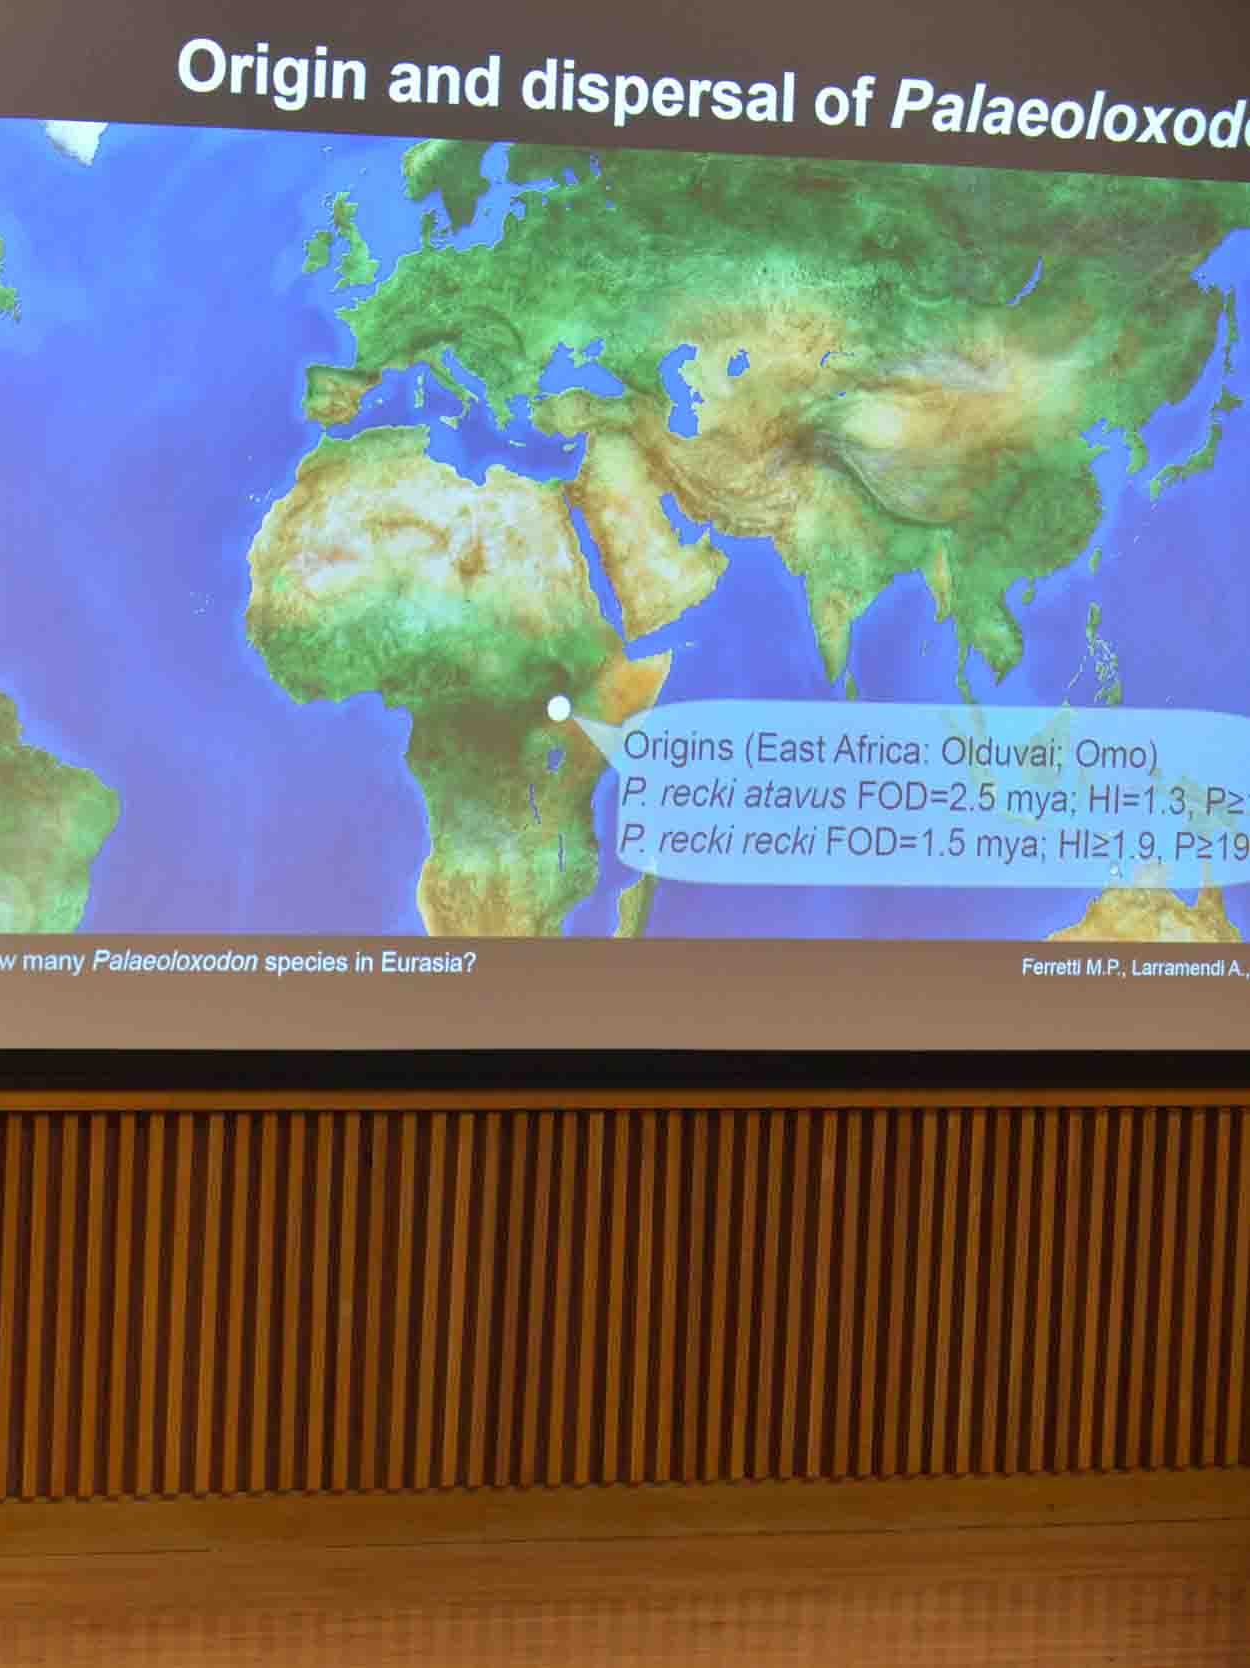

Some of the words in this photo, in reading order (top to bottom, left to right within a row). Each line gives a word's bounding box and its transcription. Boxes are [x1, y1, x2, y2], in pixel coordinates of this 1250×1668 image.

[177, 37, 367, 112] Origin
[387, 54, 502, 107] and
[521, 58, 796, 127] dispersal
[813, 75, 879, 127] of
[890, 76, 1250, 150] Palaeoloxod
[623, 730, 734, 768] Origins
[744, 731, 829, 768] (East
[833, 734, 930, 766] Africa:
[941, 736, 1063, 772] Olduvai;
[1075, 739, 1158, 776] Omo)
[622, 776, 648, 807] P.
[660, 778, 735, 810] recki
[744, 785, 846, 811] atavus
[857, 781, 996, 812] FOD=2.5
[1006, 789, 1077, 820] mya;
[1088, 784, 1193, 820] HI=1.3,
[1206, 786, 1250, 816] P≥
[620, 823, 646, 855] P.
[658, 825, 734, 857] recki
[741, 826, 816, 857] recki
[826, 828, 967, 858] FOD=1.5
[976, 835, 1048, 866] mya;
[1058, 830, 1163, 865] HI≥1.9,
[22, 955, 84, 977] many
[92, 950, 258, 973] Palaeoloxodon
[264, 953, 348, 977] species
[355, 951, 374, 972] in
[381, 952, 477, 973] Eurasia?
[1021, 958, 1081, 976] Ferretti
[1086, 959, 1126, 979] M.P.,
[1132, 960, 1225, 976] Larramendi
